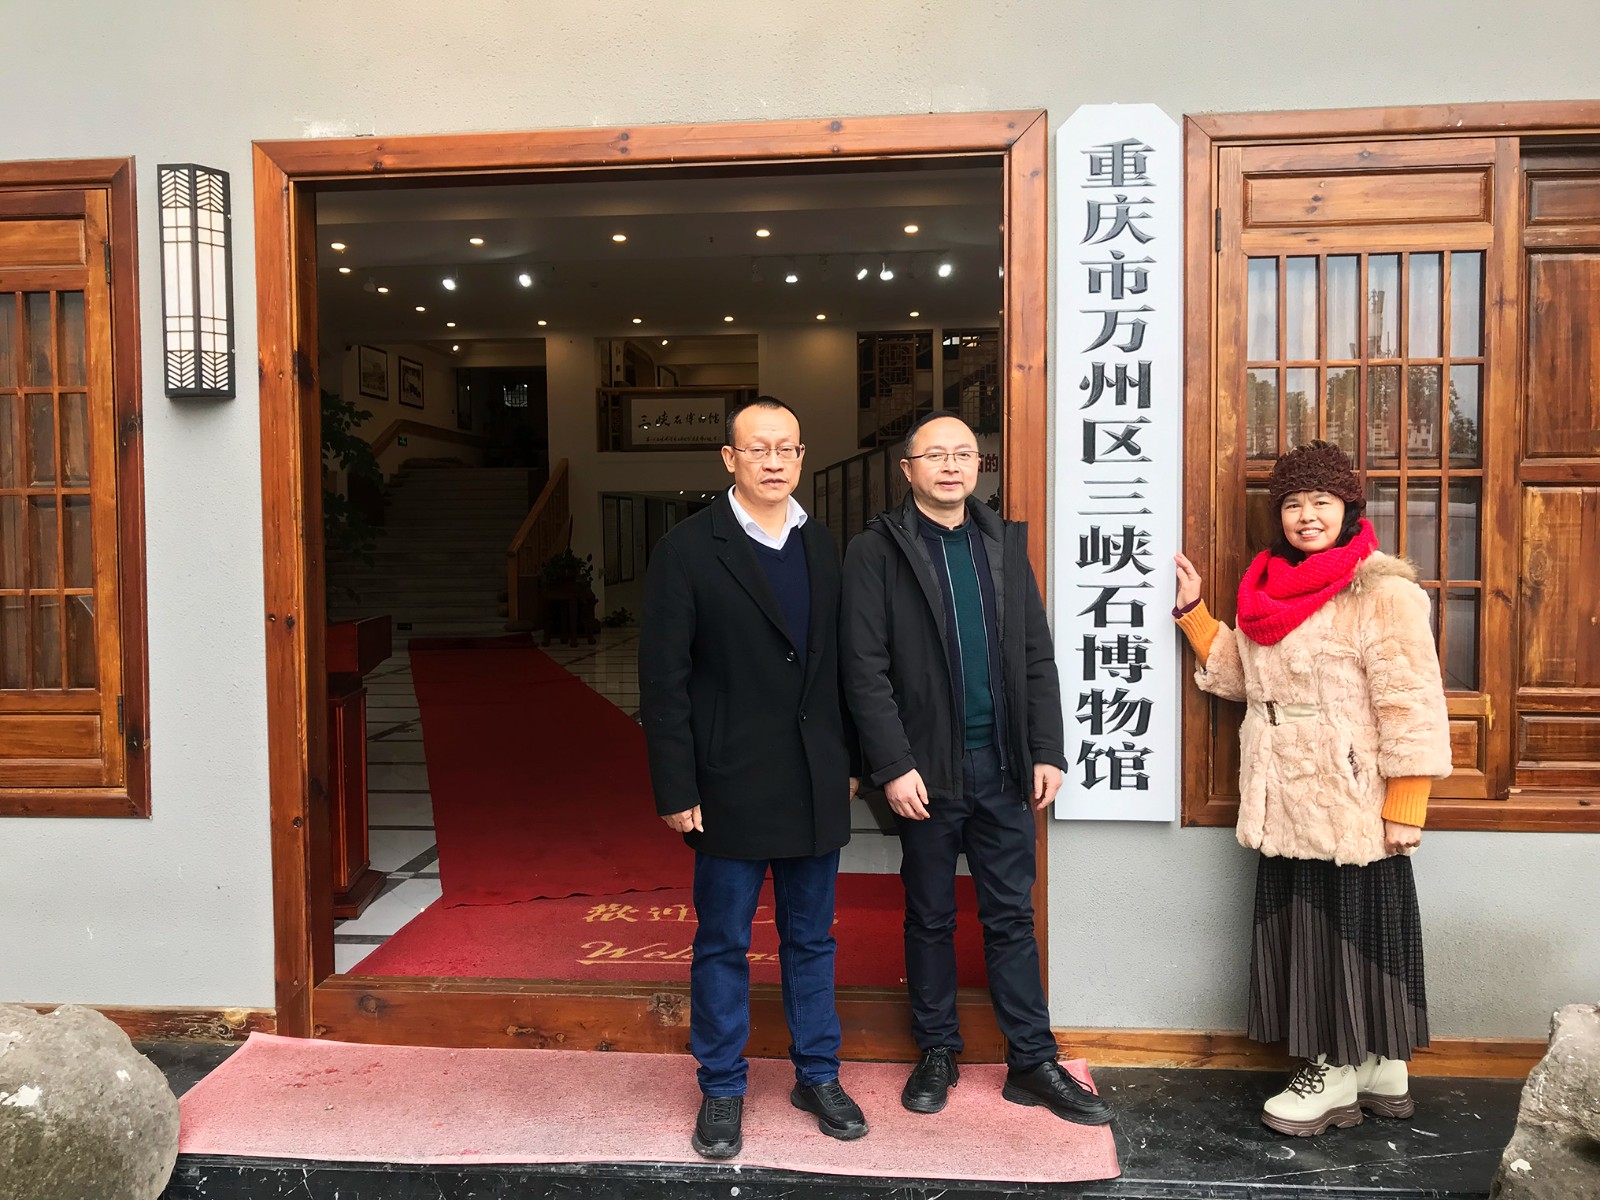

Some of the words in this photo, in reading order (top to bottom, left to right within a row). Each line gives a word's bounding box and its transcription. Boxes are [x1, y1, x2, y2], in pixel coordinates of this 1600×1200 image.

[1076, 137, 1156, 792] 重庆市万州区三峡石博物馆
